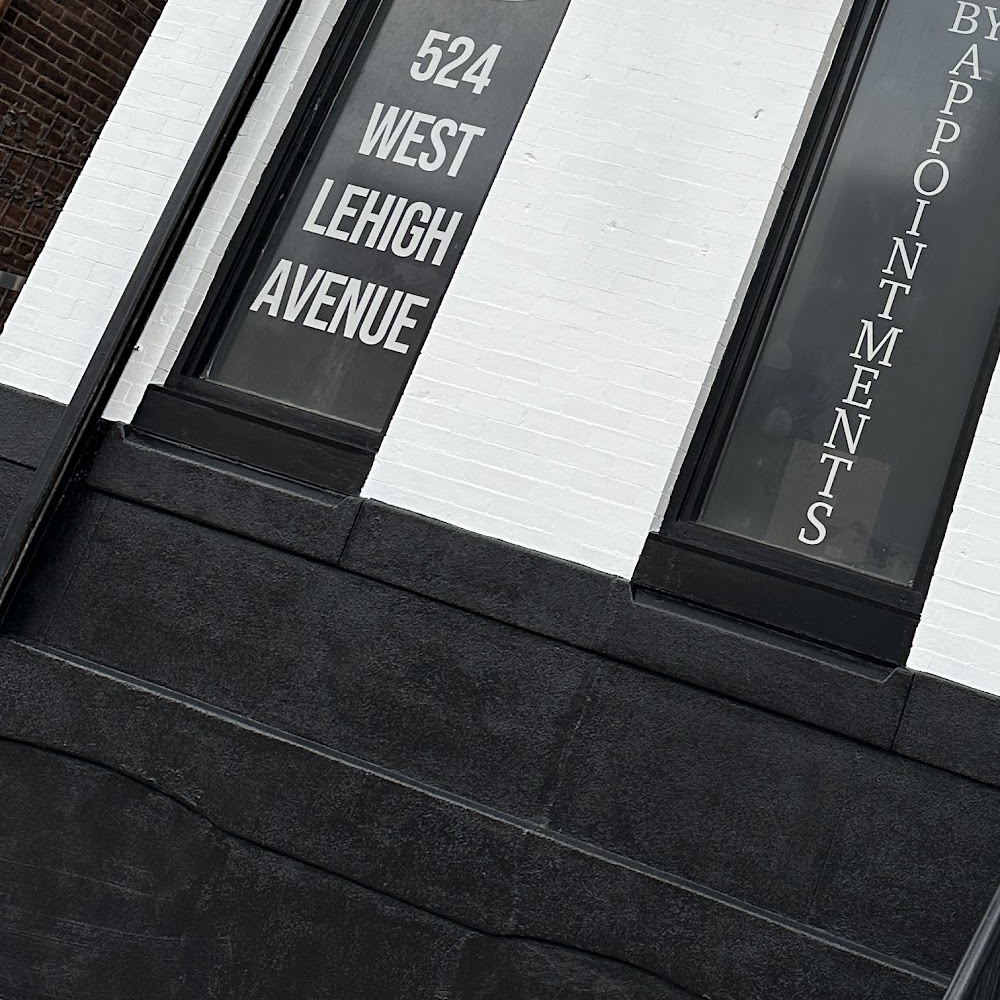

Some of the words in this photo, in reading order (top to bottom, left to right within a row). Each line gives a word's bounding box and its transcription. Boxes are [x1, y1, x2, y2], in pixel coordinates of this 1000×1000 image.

[409, 29, 502, 95] 524
[357, 102, 486, 178] WEST
[302, 178, 463, 267] LEHIGH
[249, 258, 430, 355] AVENUE
[798, 43, 982, 546] APPOINTMENTS
